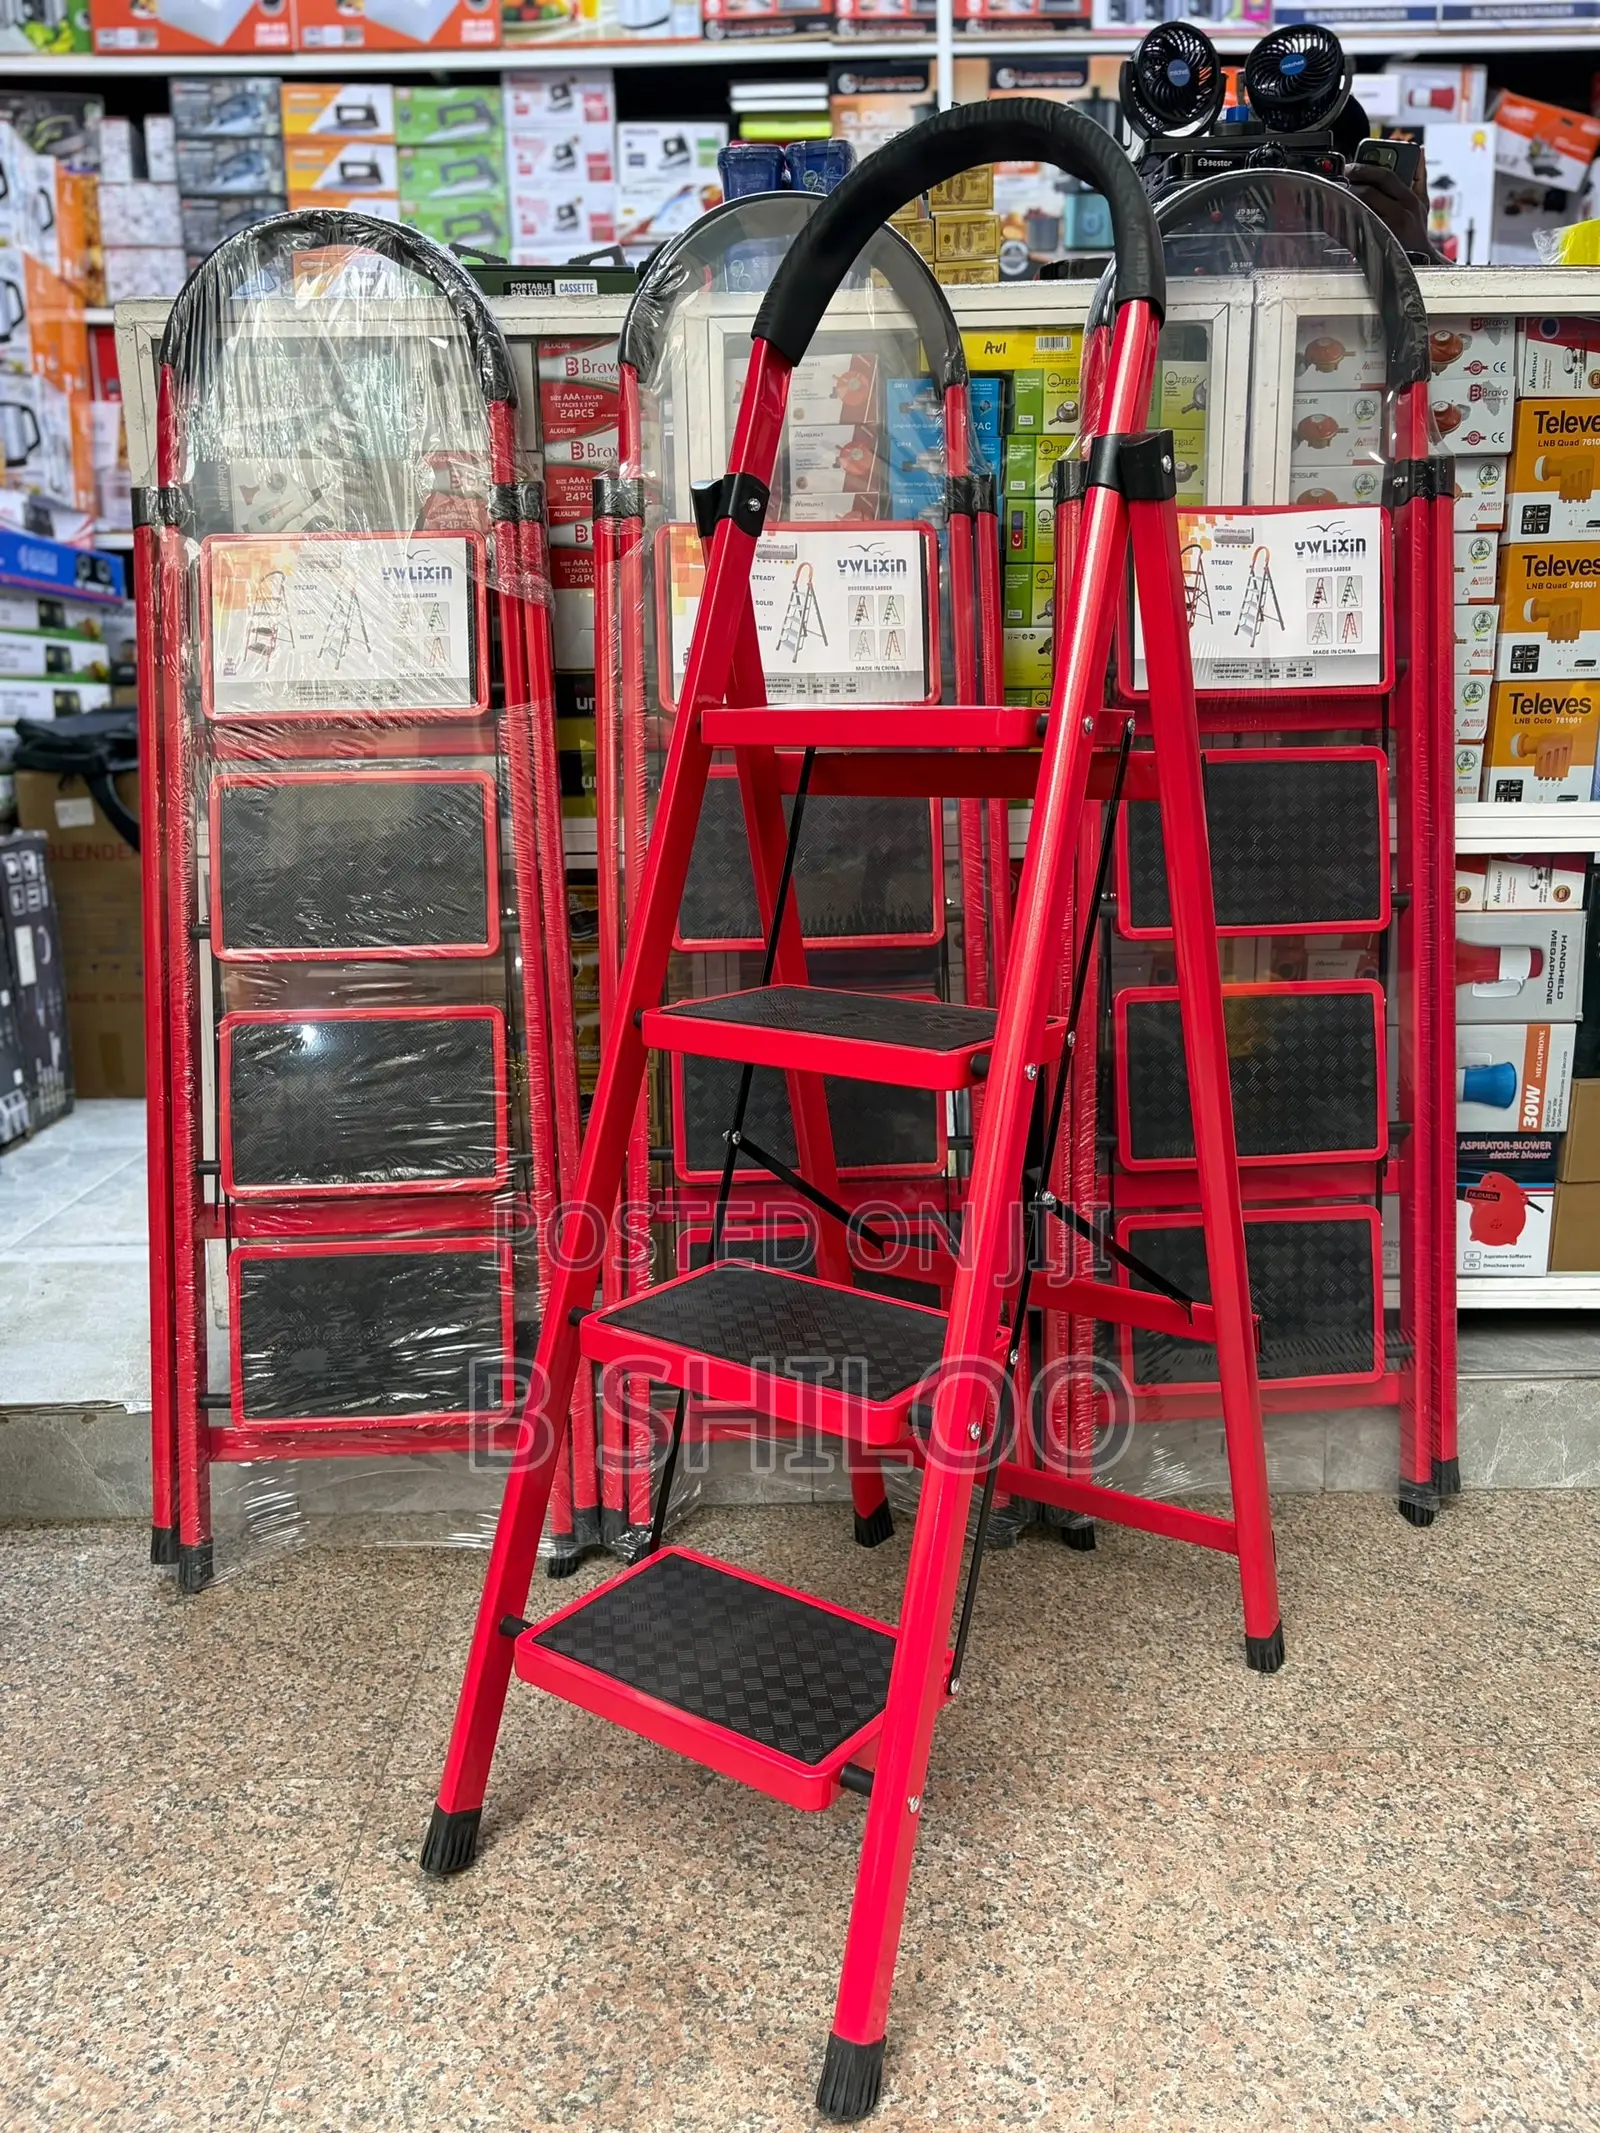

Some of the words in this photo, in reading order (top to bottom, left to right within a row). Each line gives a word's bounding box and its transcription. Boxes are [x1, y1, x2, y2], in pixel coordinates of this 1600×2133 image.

[510, 282, 552, 290] PORTABLE
[560, 283, 594, 293] CASSETTE
[563, 393, 580, 401] AAA
[1482, 388, 1509, 399] Bravo
[560, 409, 595, 418] 24PCS
[1557, 439, 1580, 447] Quad
[565, 492, 593, 501] 24PC
[1526, 582, 1544, 590] LNB
[1546, 582, 1568, 590] Quad
[1570, 581, 1597, 589] 761001
[1509, 692, 1592, 715] Televes
[1514, 717, 1531, 725] LNB
[1546, 930, 1558, 1005] MEGAPHONE
[1557, 934, 1568, 1000] HANDHELD
[1523, 1084, 1541, 1128] 30W
[1535, 1029, 1546, 1078] MEGAPHONE
[1460, 1140, 1552, 1150] ASPIRATOR-BLOWER
[1489, 1151, 1520, 1160] electric
[1521, 1151, 1551, 1160] blower
